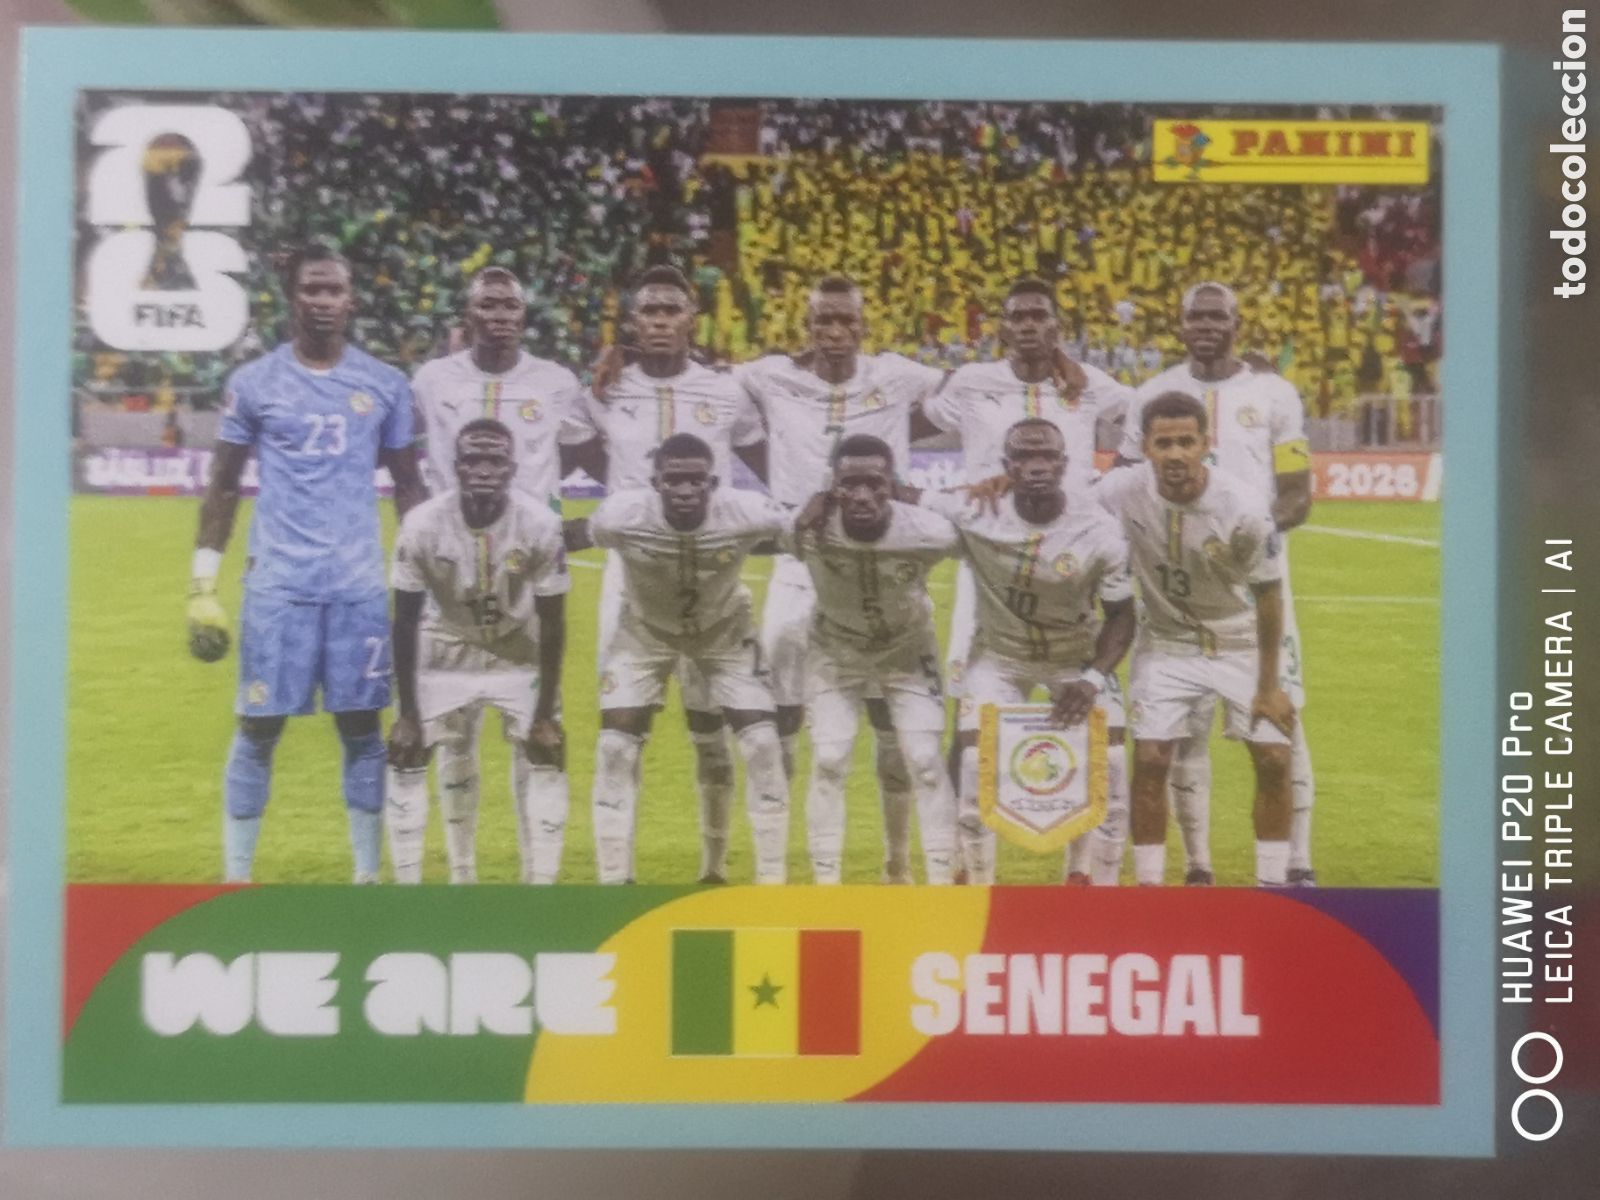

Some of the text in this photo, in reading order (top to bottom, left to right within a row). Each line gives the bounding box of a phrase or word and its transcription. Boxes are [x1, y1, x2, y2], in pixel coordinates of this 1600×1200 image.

[1230, 129, 1415, 157] PANINI
[134, 303, 206, 329] FIFA
[302, 413, 347, 456] 23
[1155, 563, 1191, 598] 13
[142, 951, 1260, 1037] WE ARE SENEGAL
